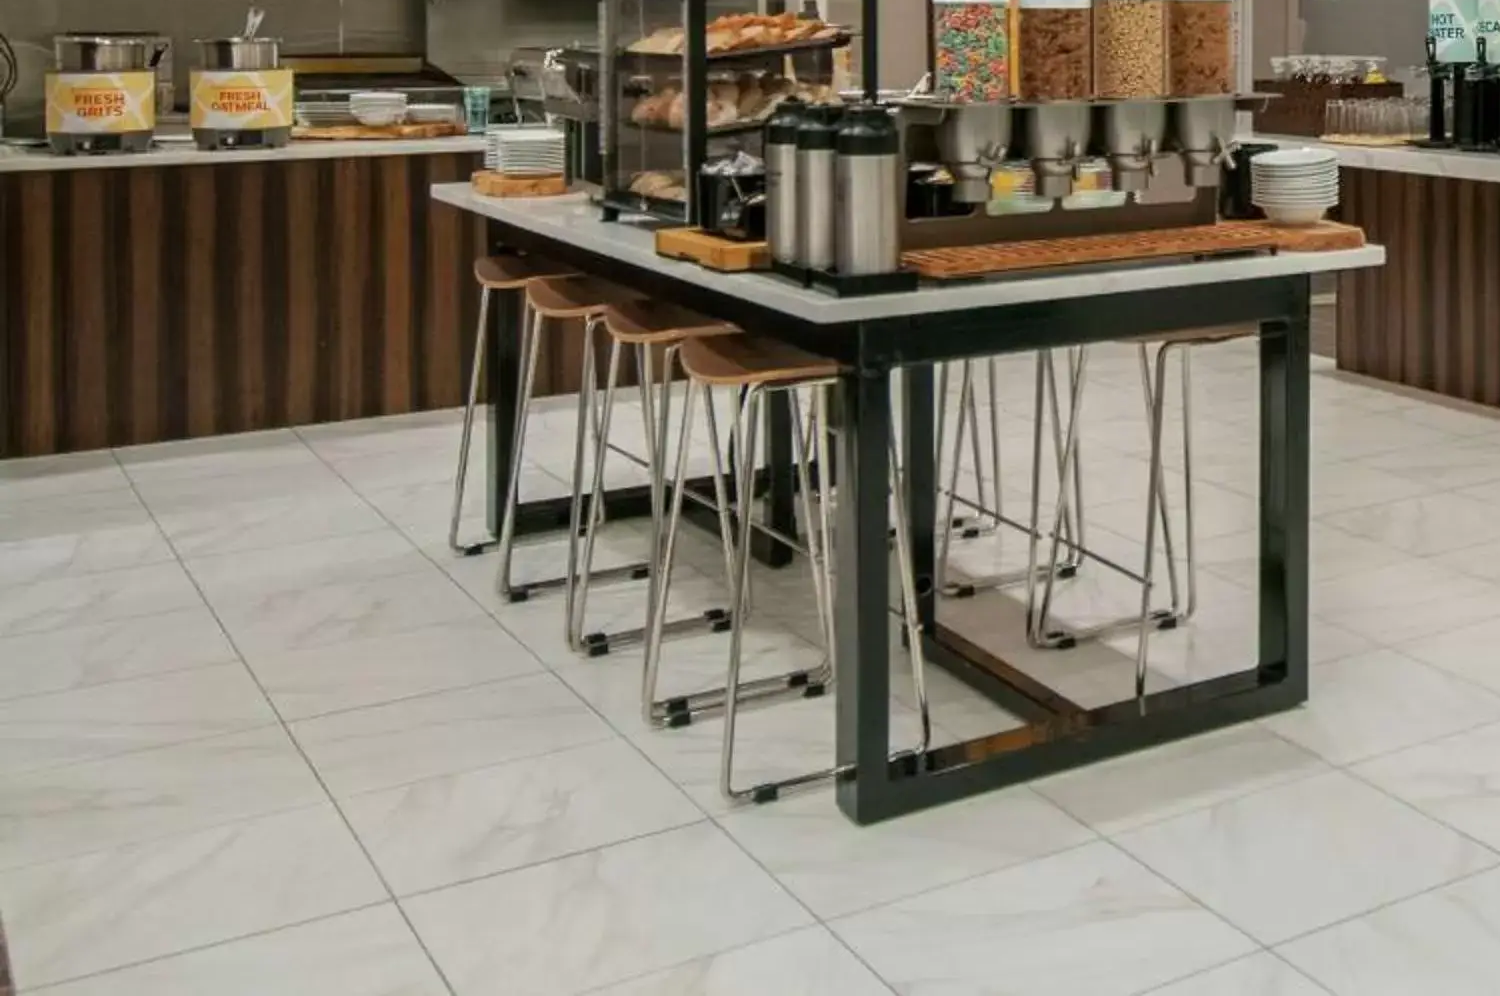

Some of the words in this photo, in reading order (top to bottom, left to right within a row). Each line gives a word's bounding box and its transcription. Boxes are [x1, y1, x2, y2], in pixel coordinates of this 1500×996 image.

[1431, 13, 1456, 24] HOT
[74, 94, 125, 105] FRESH
[219, 91, 261, 101] FRESH
[76, 105, 123, 117] GRITS
